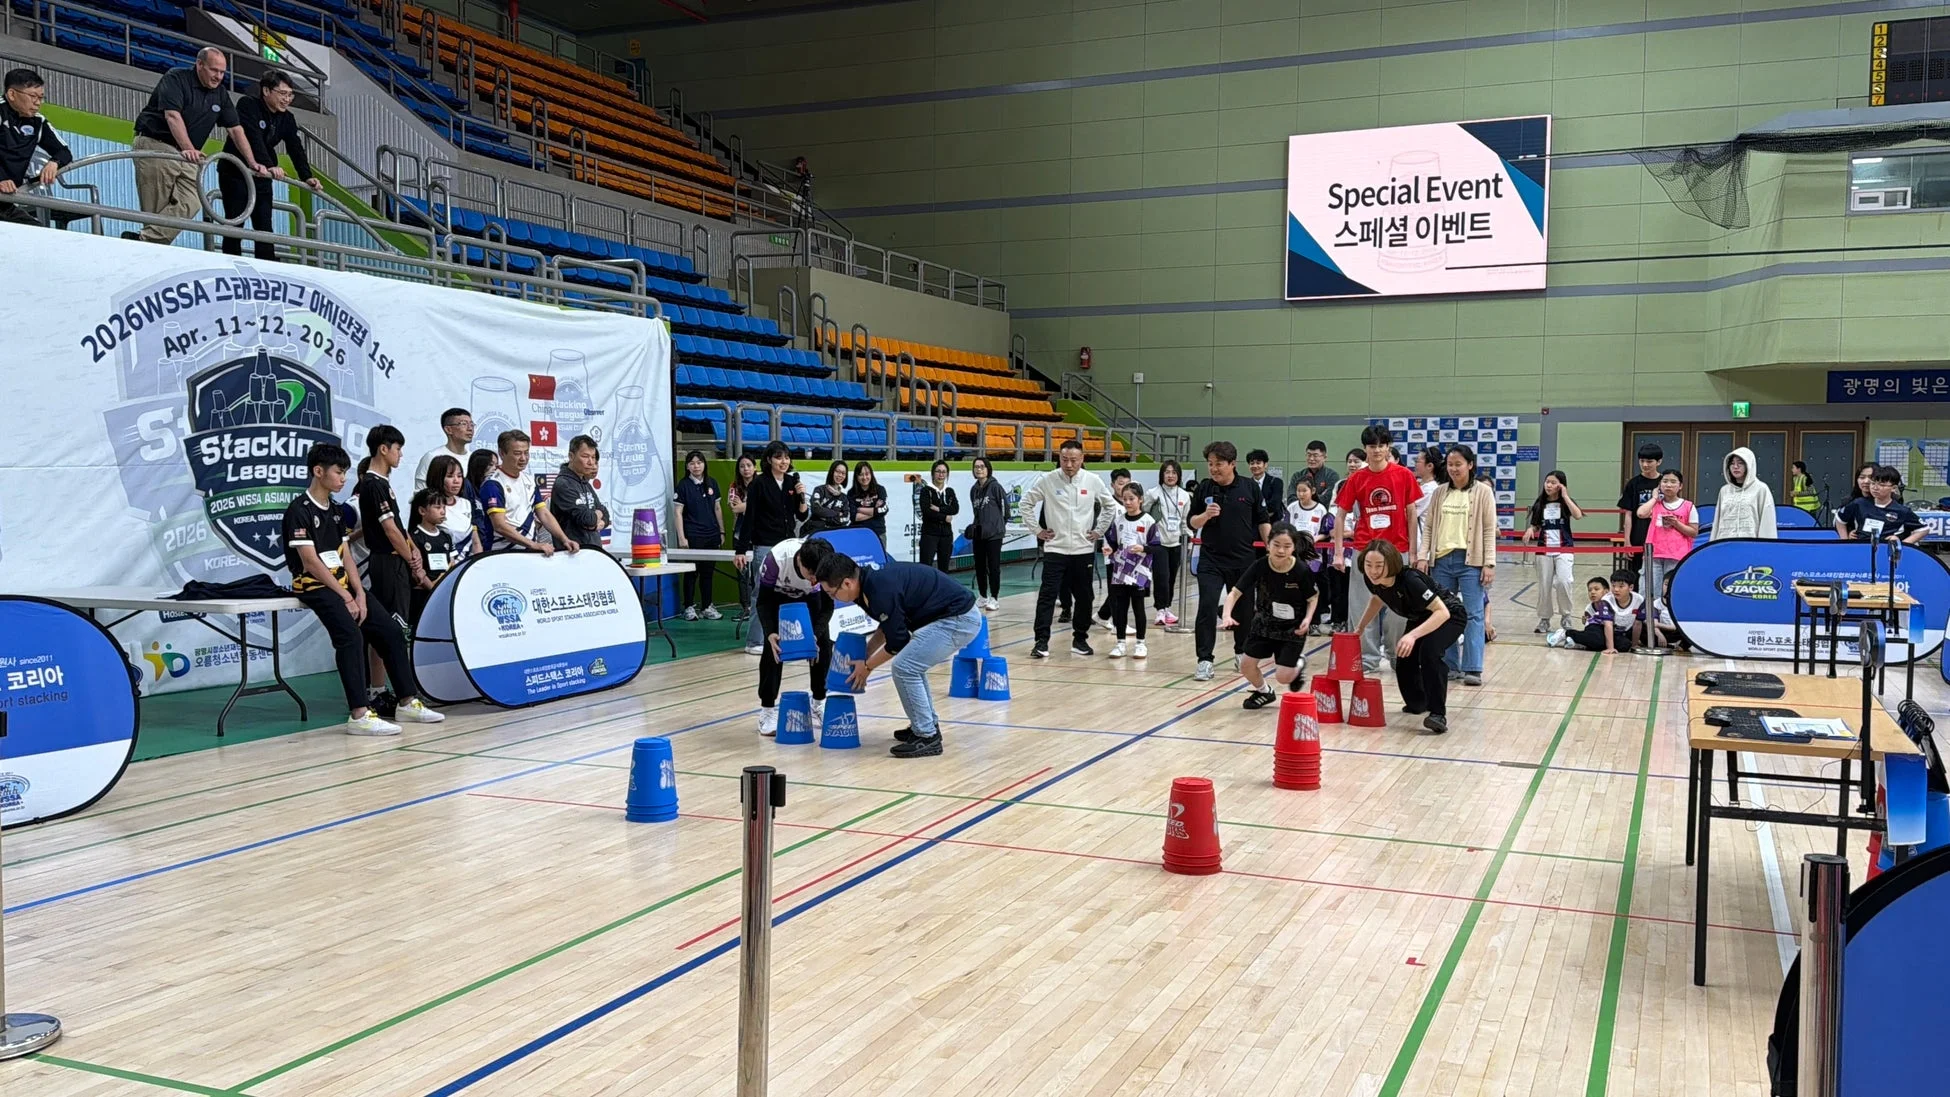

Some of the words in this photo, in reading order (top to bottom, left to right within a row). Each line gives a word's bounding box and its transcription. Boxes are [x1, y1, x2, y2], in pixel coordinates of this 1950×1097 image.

[1877, 25, 1883, 34] 1
[1876, 37, 1884, 46] 2
[1875, 61, 1883, 69] 4
[1875, 72, 1883, 81] 5
[1874, 96, 1882, 105] 7
[1327, 175, 1420, 215] Special
[1427, 173, 1503, 202] Event
[1334, 215, 1408, 249] 스페셜
[1415, 211, 1493, 245] 이벤트
[80, 279, 211, 364] 2026WSSA
[215, 276, 304, 307] 스태킹리그
[309, 288, 371, 349] 아시안컵
[368, 341, 397, 380] 1st
[163, 326, 208, 359] Apr.
[214, 315, 292, 338] 11~12.
[300, 324, 346, 366] 2026
[1843, 377, 1900, 396] 광명의
[531, 402, 553, 414] China
[226, 462, 308, 484] League
[210, 497, 235, 514] 2026
[236, 494, 262, 508] WSSA
[264, 492, 291, 504] ASIAN
[163, 520, 208, 552] 2026
[1723, 585, 1778, 594] STACKS
[532, 590, 617, 615] 대한스포츠스태킹협회
[497, 614, 521, 625] WSSA
[536, 616, 551, 624] WORLD
[551, 615, 564, 623] SPORT
[564, 613, 583, 621] STACKING
[7, 666, 64, 691] 코리아
[565, 666, 584, 679] 코리아
[527, 687, 536, 695] The
[536, 684, 551, 694] Leader
[557, 681, 569, 690] Sport
[569, 678, 586, 687] stacking
[18, 690, 68, 708] stacking
